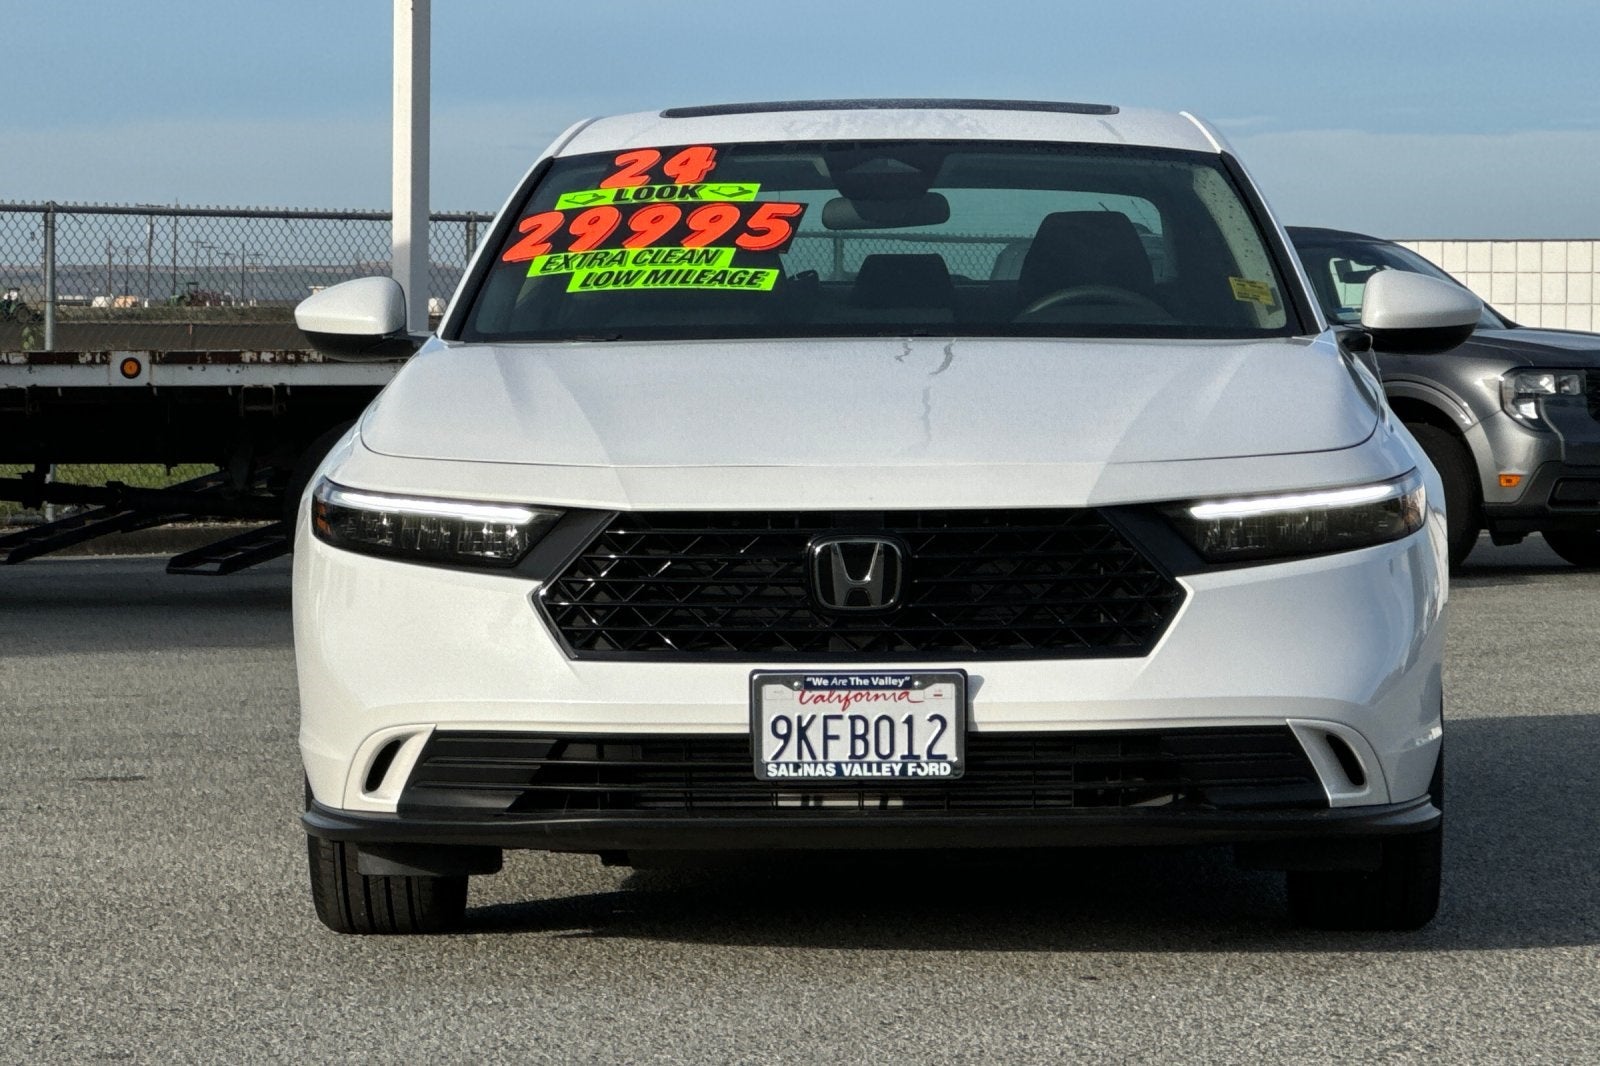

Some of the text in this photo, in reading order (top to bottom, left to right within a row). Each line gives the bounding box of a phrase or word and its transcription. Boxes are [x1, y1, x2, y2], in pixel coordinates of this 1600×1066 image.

[600, 146, 717, 188] 24
[612, 184, 705, 202] LOOK
[502, 203, 803, 262] 29995
[540, 248, 720, 273] EXTRA CLEAN
[578, 269, 766, 288] LOW MILEAGE
[831, 677, 848, 686] Are
[850, 676, 870, 686] The
[799, 689, 924, 712] California
[770, 713, 948, 760] 9KFB012
[767, 762, 951, 777] SALINAS VALLEY FORD
